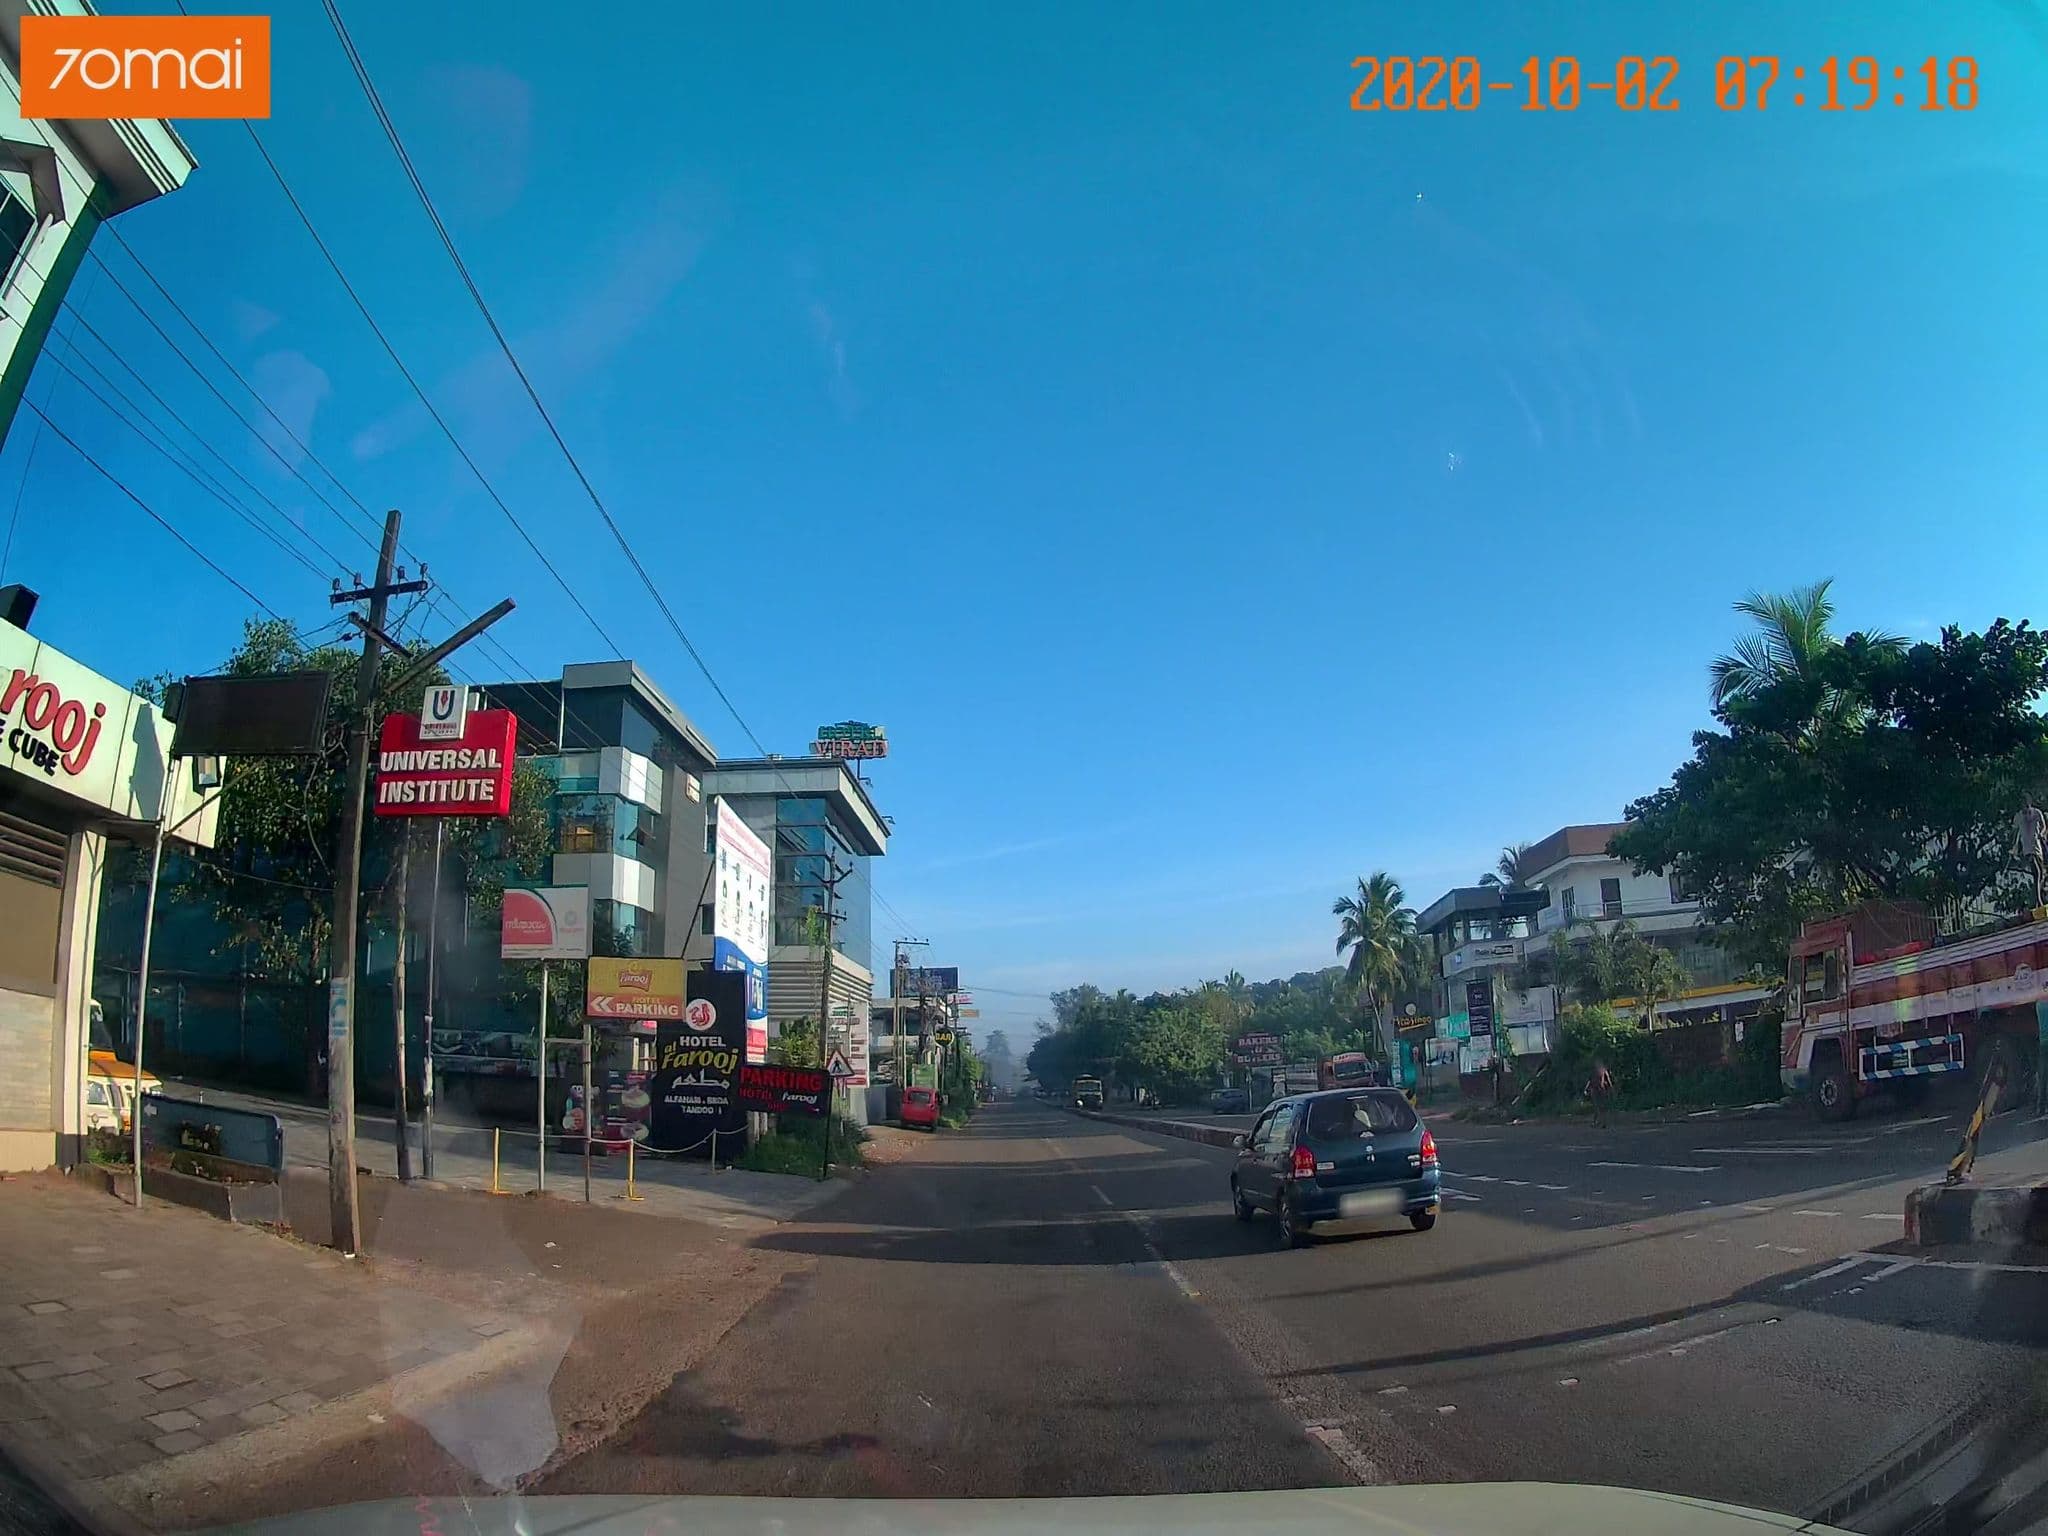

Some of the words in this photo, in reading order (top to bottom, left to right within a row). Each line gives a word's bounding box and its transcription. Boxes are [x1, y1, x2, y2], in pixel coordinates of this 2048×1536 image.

[8, 728, 60, 776] CUBE
[380, 748, 502, 772] UNIVERSAL
[379, 779, 495, 804] INSTITUTE
[616, 1003, 678, 1016] PARKING
[664, 1041, 676, 1053] al
[680, 1036, 727, 1047] HOTEL
[661, 1048, 740, 1075] Farooj
[672, 1068, 730, 1090] مطعم
[740, 1066, 823, 1092] PARKING
